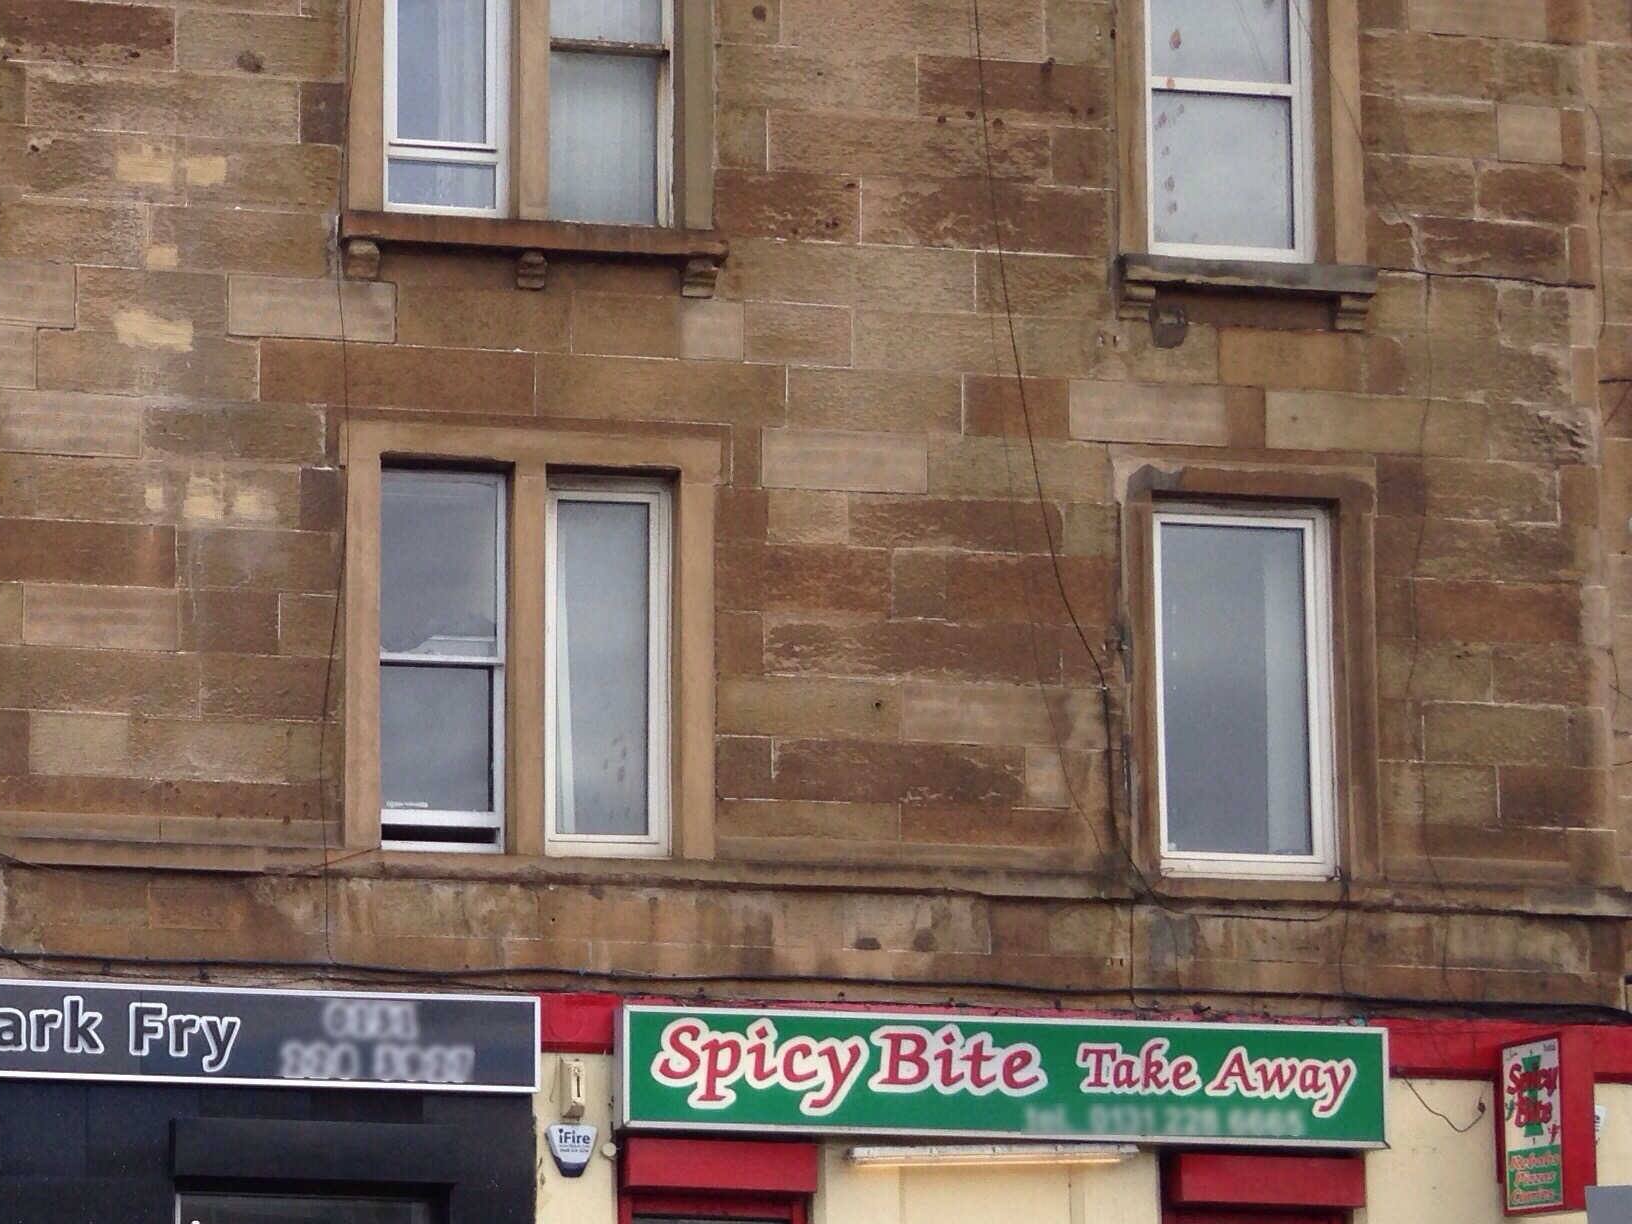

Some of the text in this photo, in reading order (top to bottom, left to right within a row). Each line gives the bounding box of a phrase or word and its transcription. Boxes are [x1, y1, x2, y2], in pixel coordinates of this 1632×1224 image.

[129, 1001, 241, 1073] Fry
[654, 1019, 1354, 1116] Spicy Bite Take Away
[558, 1128, 591, 1144] iFire
